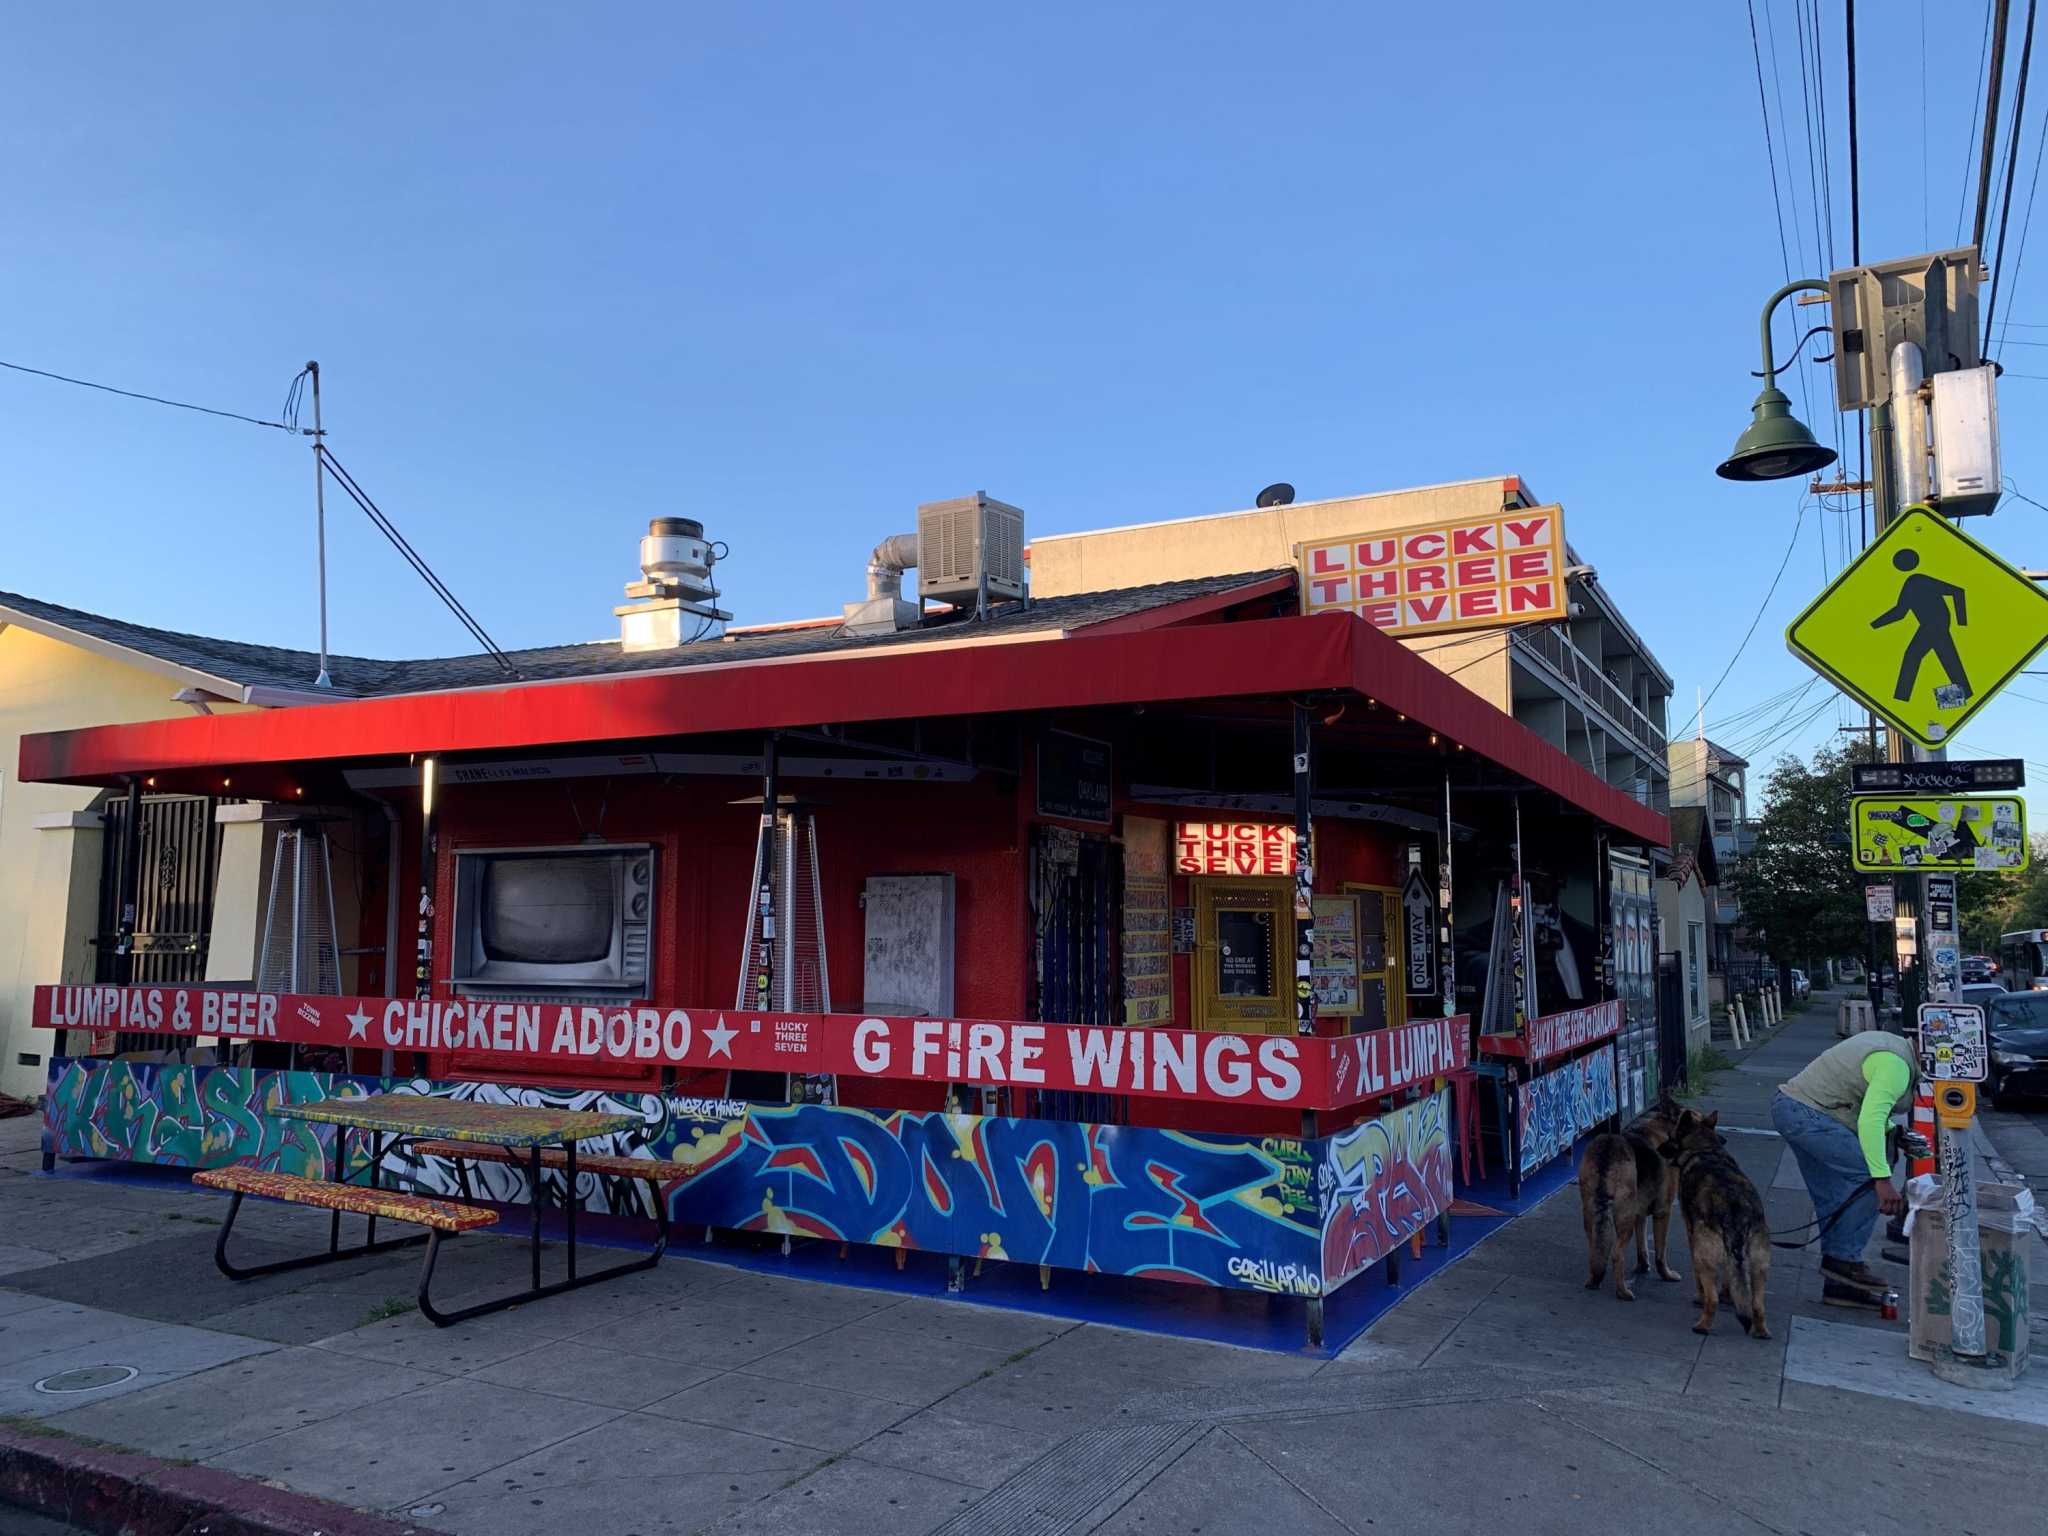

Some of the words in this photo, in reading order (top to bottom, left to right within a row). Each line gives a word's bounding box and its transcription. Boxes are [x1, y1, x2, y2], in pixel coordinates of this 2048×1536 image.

[1313, 518, 1548, 574] LUCKY
[1312, 551, 1549, 603] THREE
[1312, 583, 1551, 628] EVEN
[1178, 823, 1297, 840] LUCK
[1178, 841, 1297, 858] THRE
[1179, 857, 1297, 875] SEVE
[1410, 912, 1426, 945] WAY
[1412, 952, 1426, 985] ONE
[49, 986, 164, 1030] LUMPIAS
[173, 992, 192, 1032] &
[201, 991, 279, 1037] BEER
[775, 1021, 808, 1032] LUCKY
[383, 1000, 540, 1053] CHICKEN
[551, 1007, 693, 1061] ADOBO
[774, 1031, 808, 1042] THREE
[774, 1042, 808, 1053] SEVEN
[852, 1018, 891, 1074] G
[912, 1020, 1046, 1083] FIRE
[1066, 1028, 1302, 1101] WINGS
[1355, 1034, 1384, 1097] XL
[1389, 1020, 1456, 1086] LUMPIA
